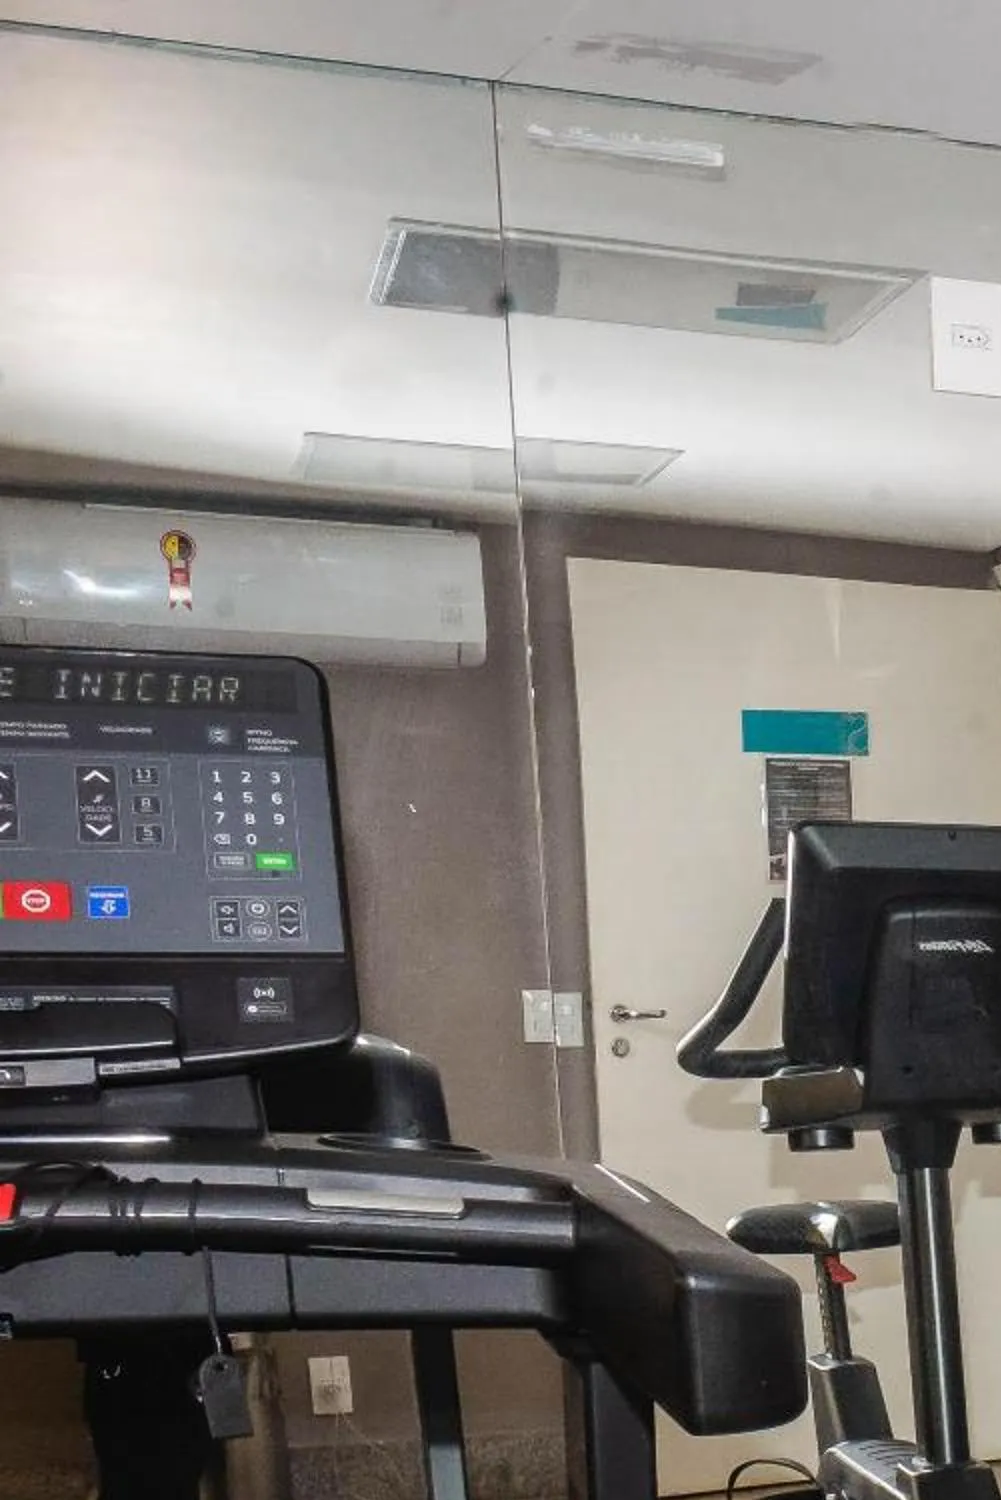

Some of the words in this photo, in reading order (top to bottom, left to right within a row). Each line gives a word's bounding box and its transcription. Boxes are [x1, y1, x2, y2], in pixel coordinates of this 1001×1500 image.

[55, 669, 240, 703] INICIAR
[135, 768, 152, 780] 11
[212, 771, 221, 783] 1
[241, 771, 252, 783] 2
[271, 771, 280, 784] 3
[213, 791, 224, 802] 4
[243, 791, 253, 803] 5
[271, 791, 283, 805] 6
[214, 811, 225, 824] 7
[245, 812, 256, 825] 8
[273, 813, 285, 825] 9
[246, 833, 257, 845] 0
